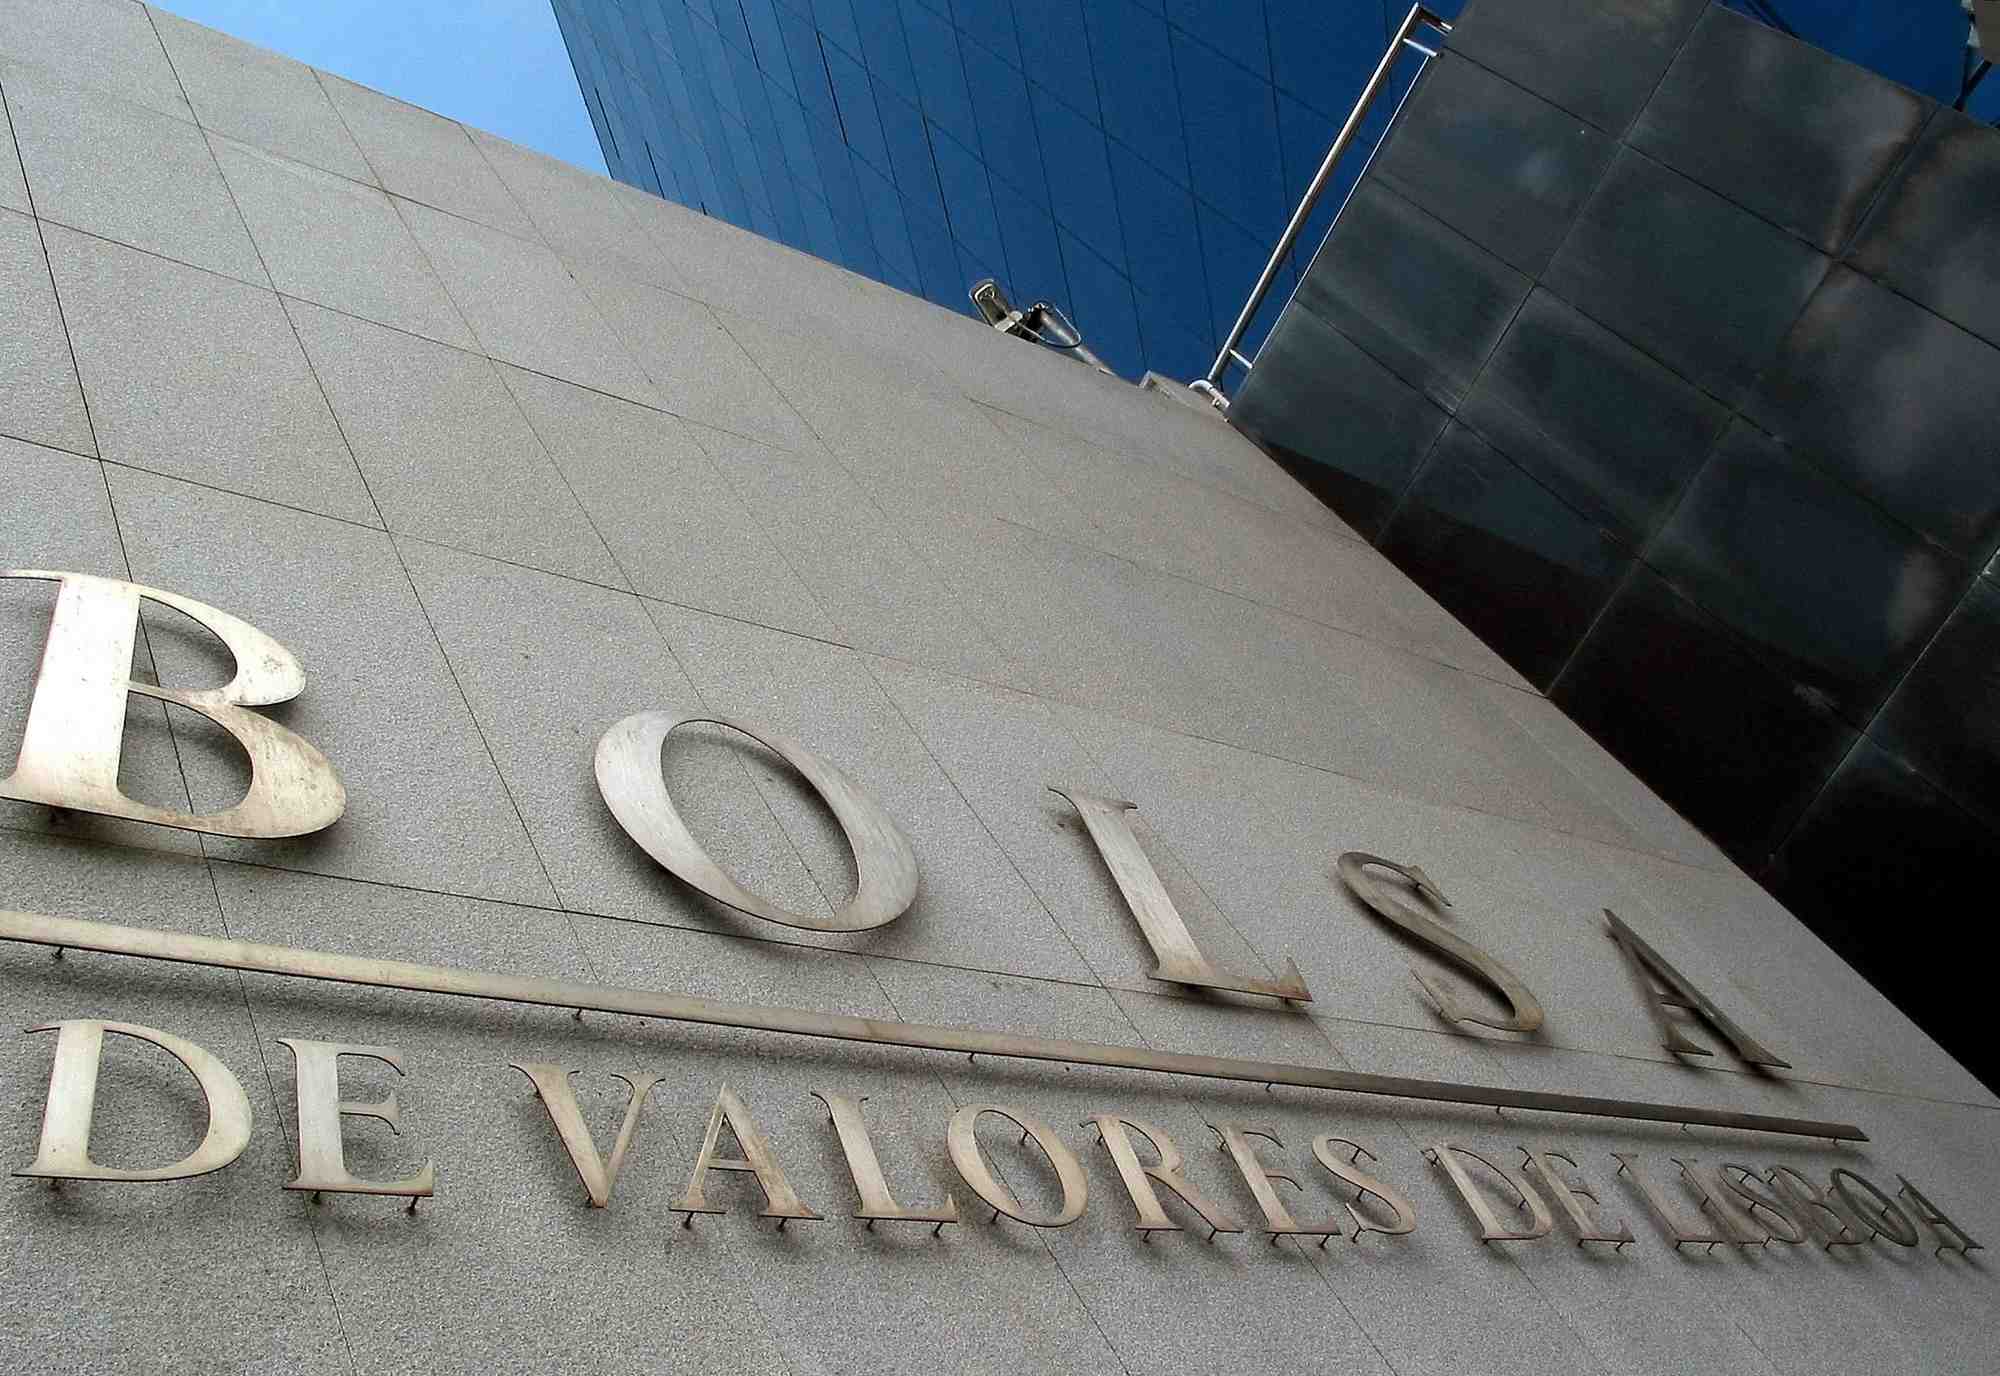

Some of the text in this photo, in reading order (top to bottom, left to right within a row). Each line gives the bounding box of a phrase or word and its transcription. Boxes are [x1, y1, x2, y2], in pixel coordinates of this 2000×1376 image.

[0, 569, 1792, 1069] BOLSA
[12, 1018, 1984, 1250] DE VALORES DE LISBOA
